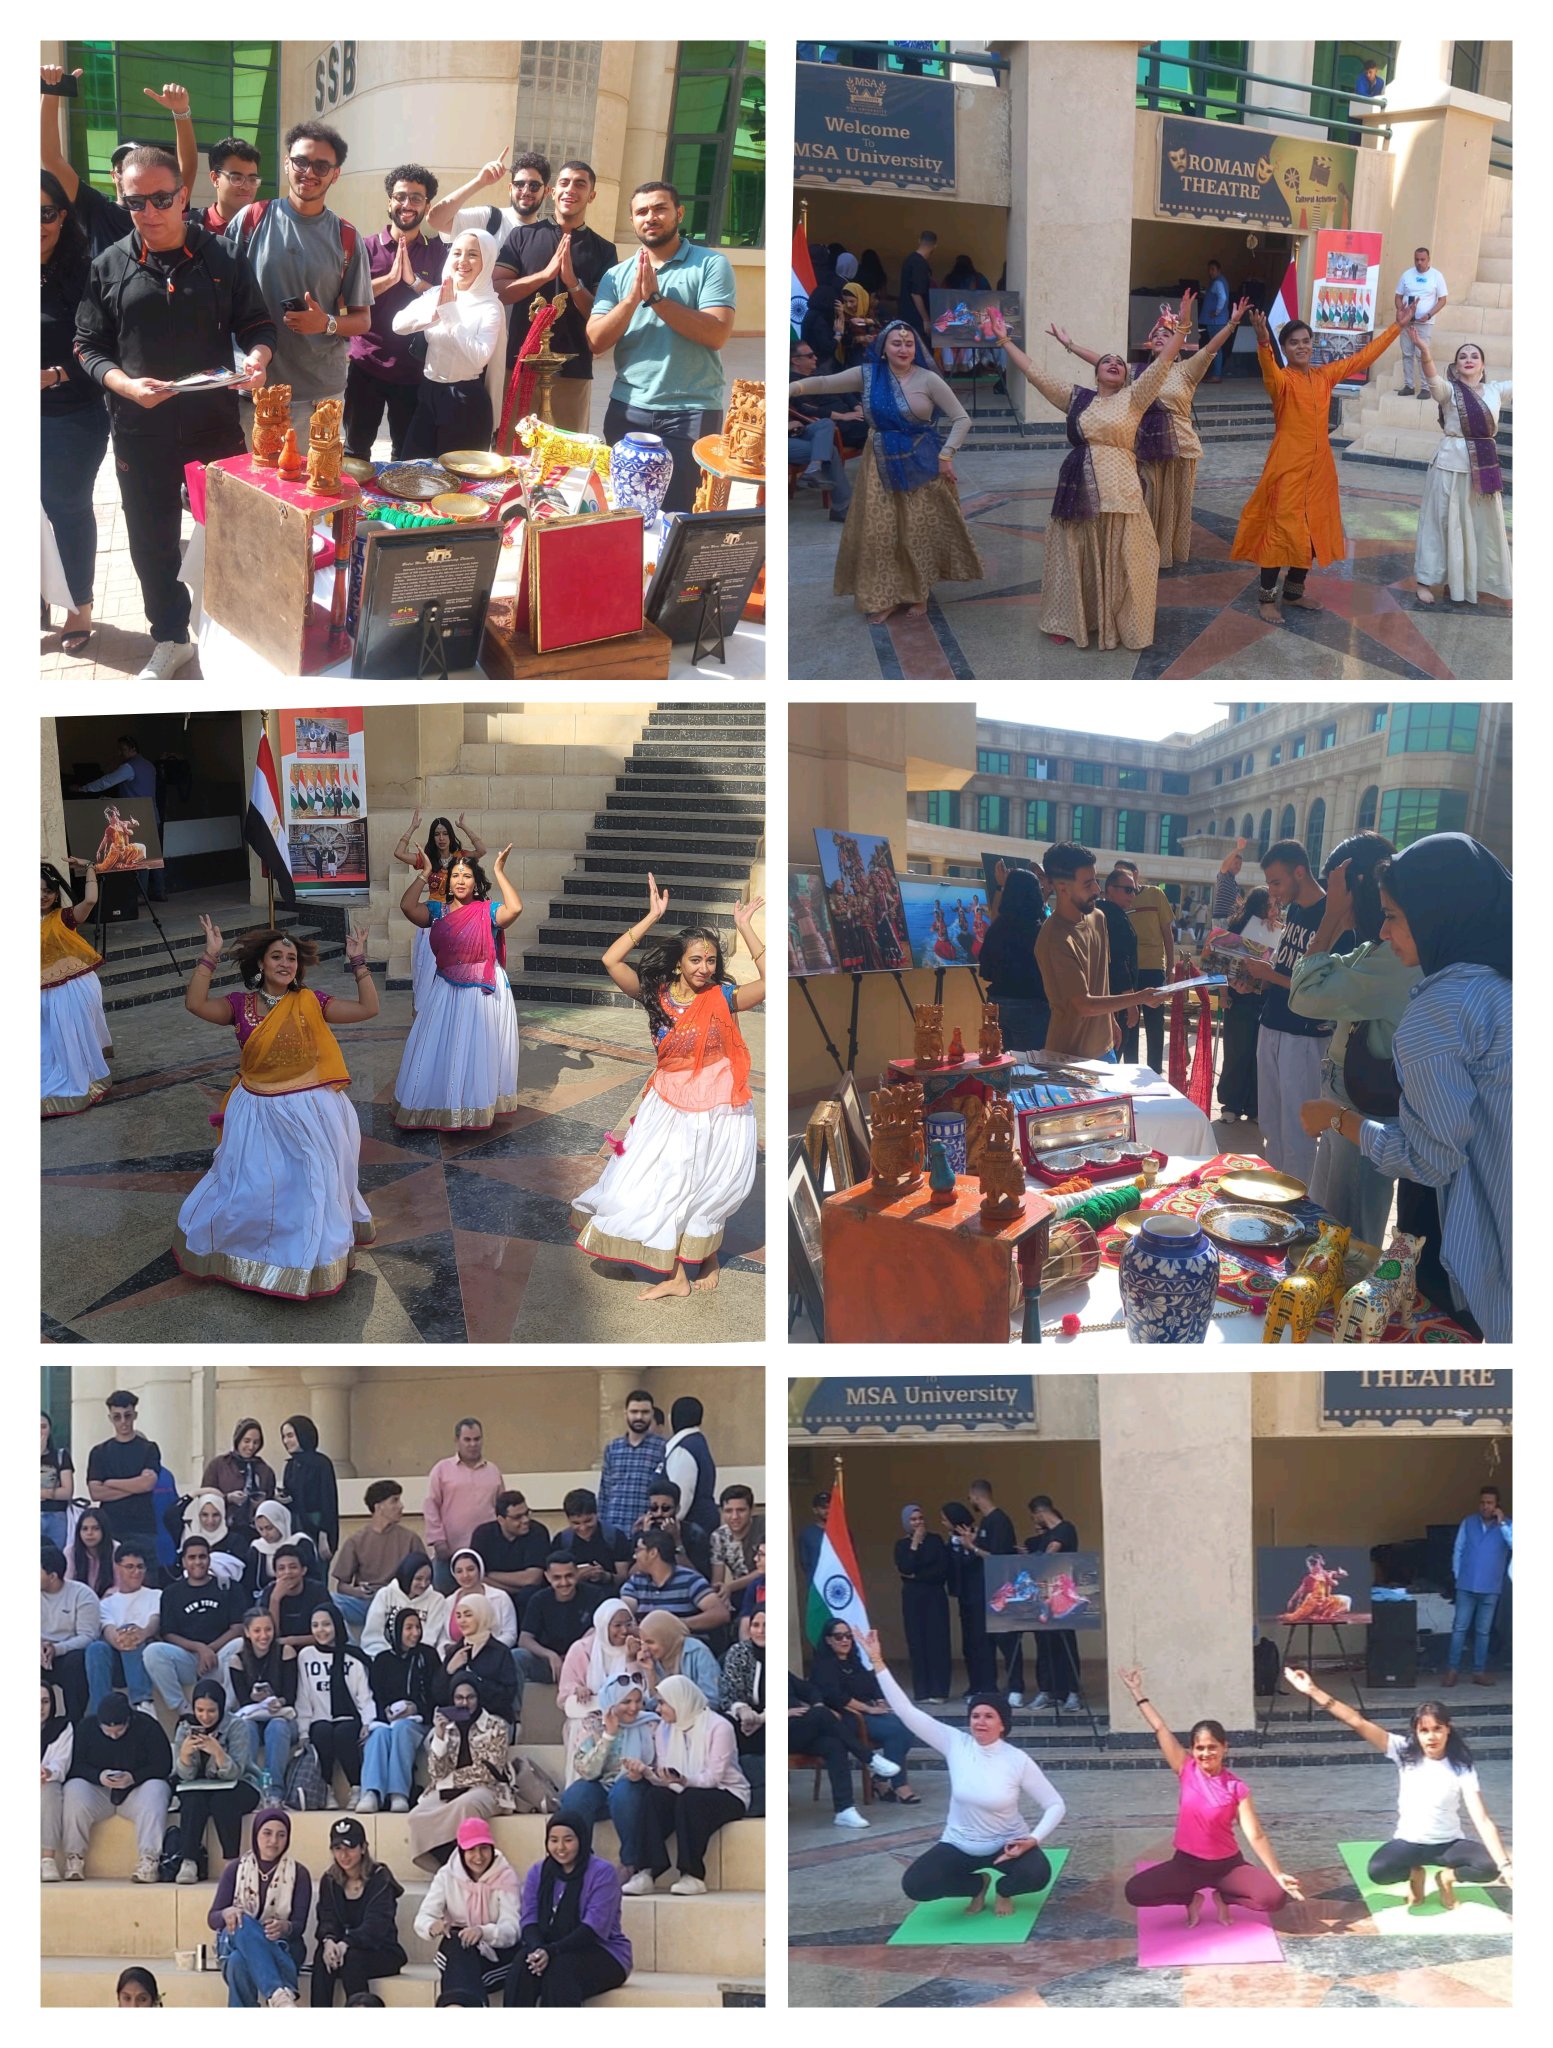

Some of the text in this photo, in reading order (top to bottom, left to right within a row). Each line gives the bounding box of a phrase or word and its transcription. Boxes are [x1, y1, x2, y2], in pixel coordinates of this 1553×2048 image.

[315, 41, 357, 112] SSB
[855, 77, 878, 88] MSA
[825, 116, 911, 139] Welcome
[862, 138, 875, 148] To
[795, 142, 943, 173] MSA University
[1189, 154, 1256, 179] ROMAN
[1181, 175, 1261, 200] THEATRE
[1359, 1369, 1496, 1388] THEATRE
[846, 1384, 1019, 1406] MSA University
[184, 1601, 199, 1614] NEW
[200, 1599, 219, 1609] YORK
